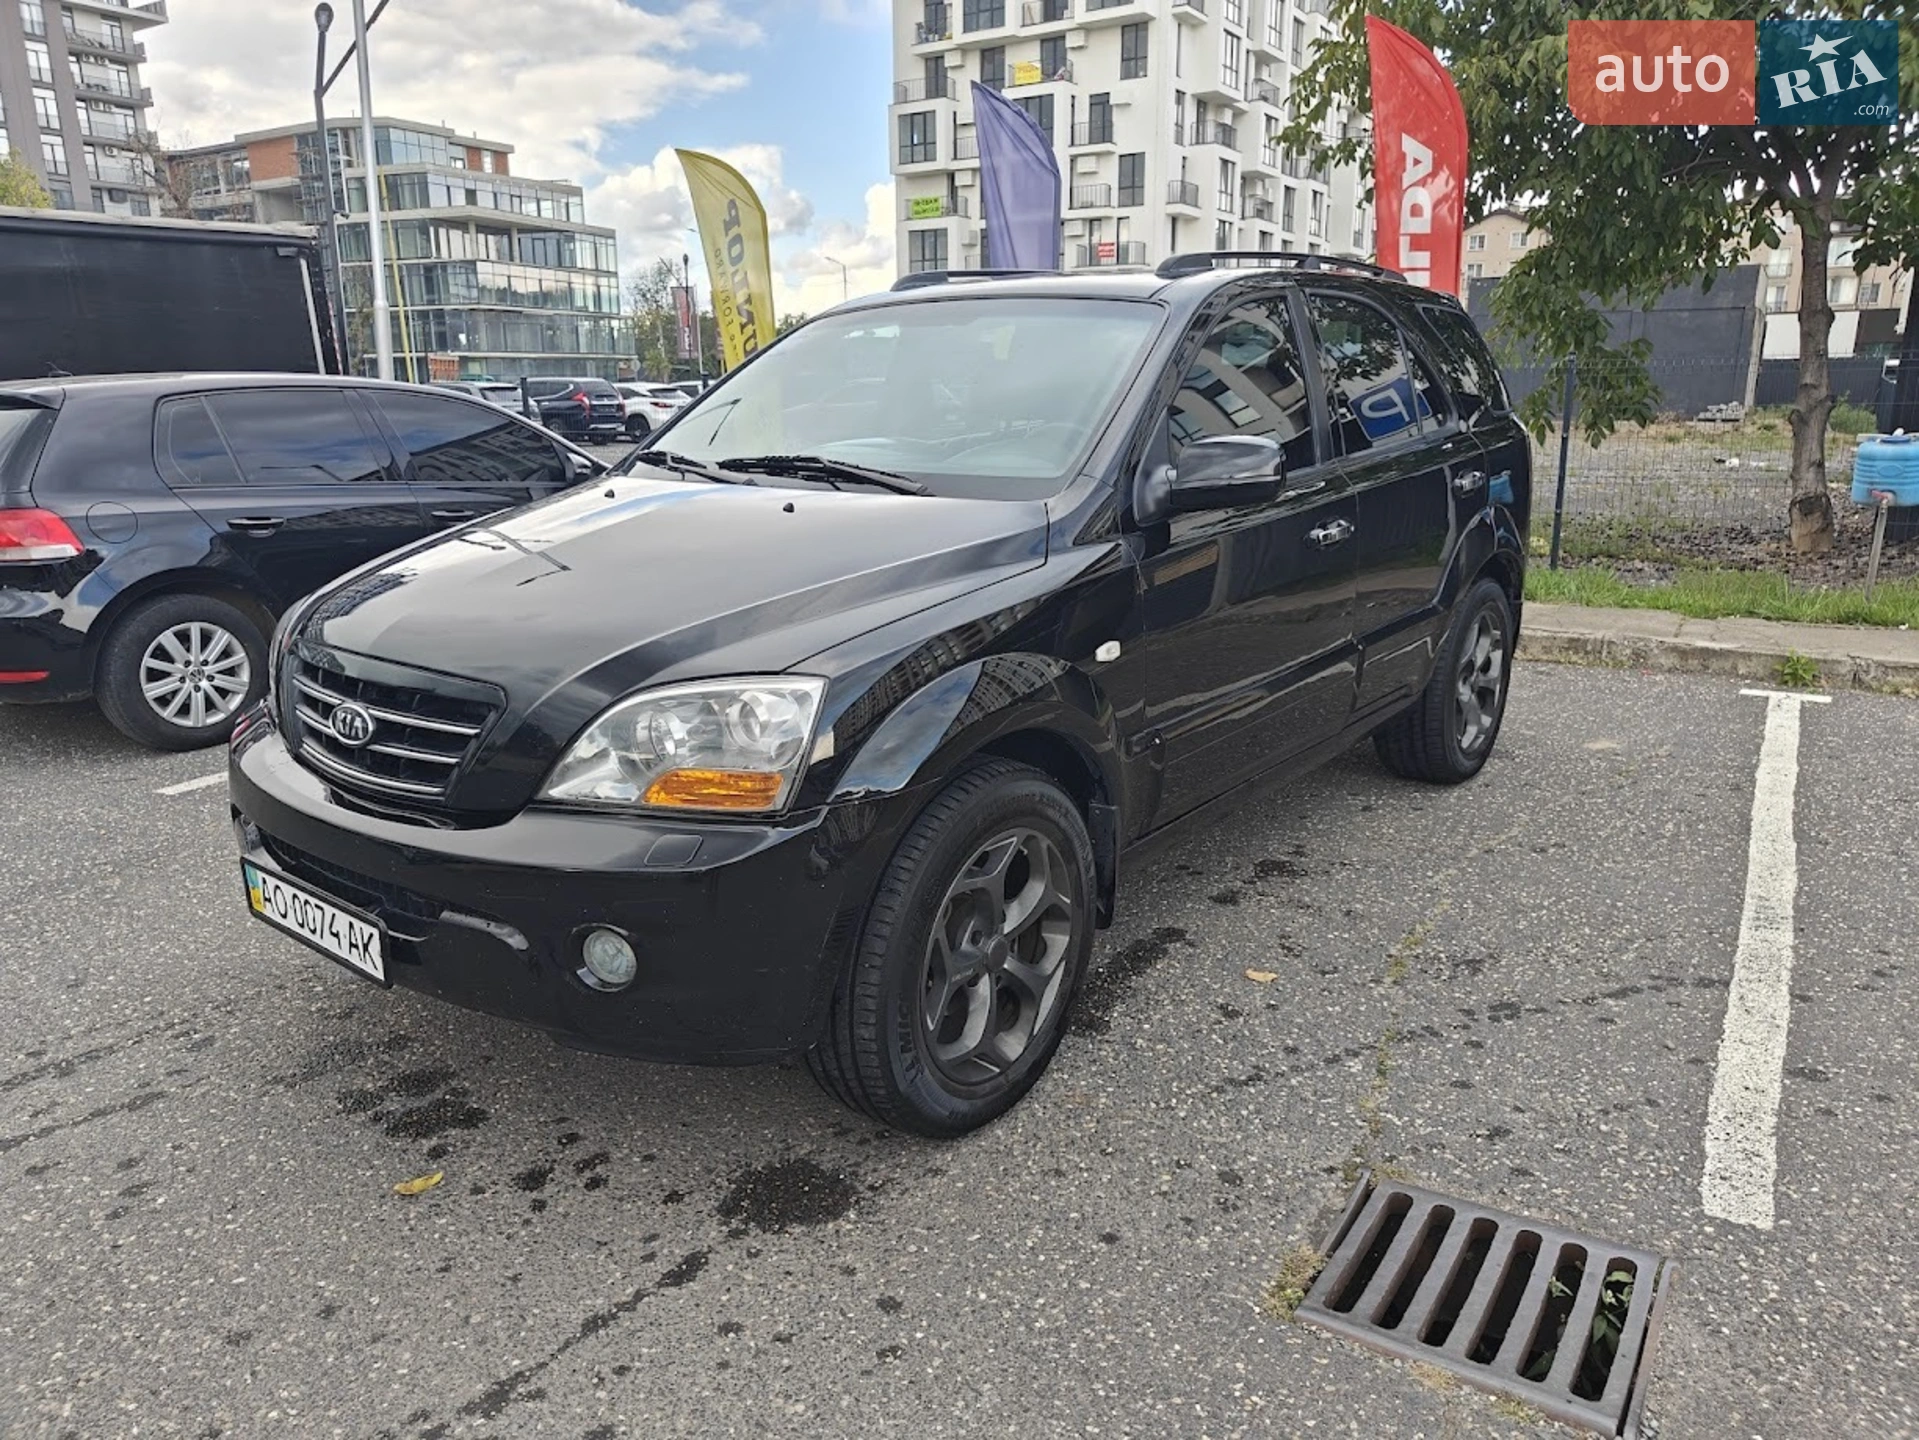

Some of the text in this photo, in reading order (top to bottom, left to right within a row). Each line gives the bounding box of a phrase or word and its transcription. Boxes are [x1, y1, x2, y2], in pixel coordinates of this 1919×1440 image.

[335, 711, 363, 738] KIA
[261, 877, 378, 970] AO 0074 AK
